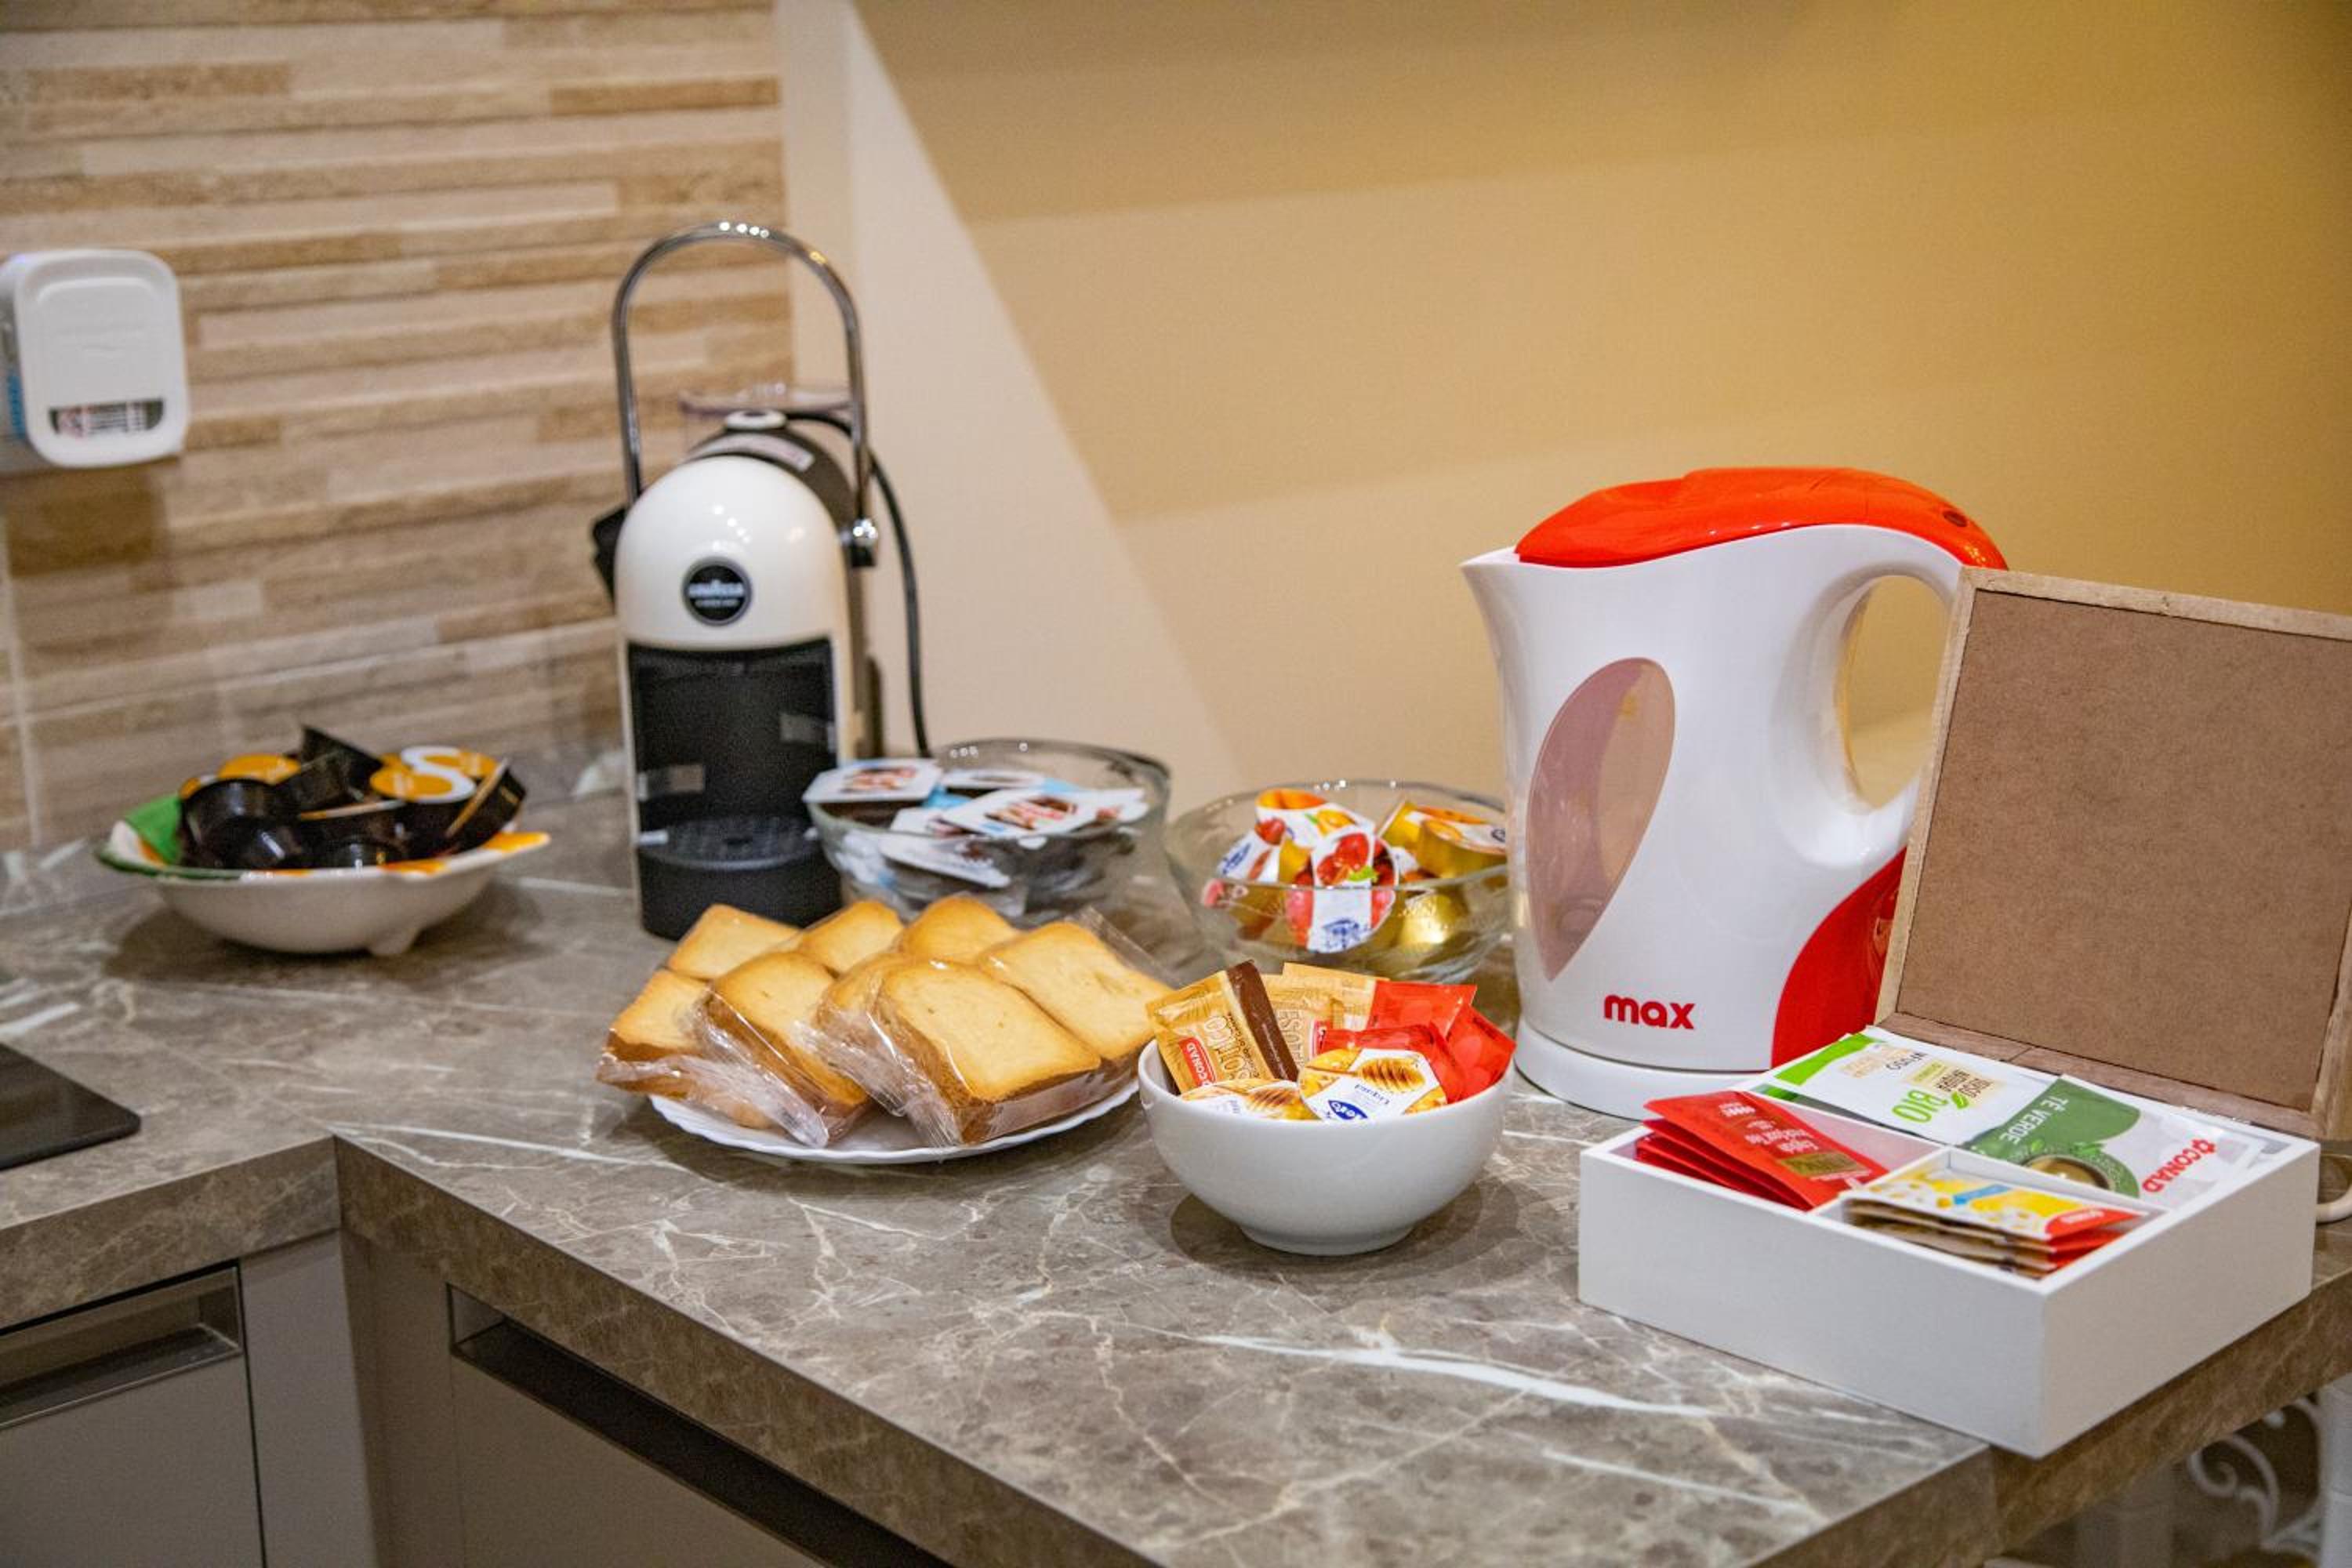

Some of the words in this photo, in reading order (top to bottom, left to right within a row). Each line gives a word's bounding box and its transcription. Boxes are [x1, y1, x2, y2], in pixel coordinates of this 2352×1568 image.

[1604, 994, 1695, 1030] max
[1892, 1091, 1949, 1123] BIO
[2142, 1148, 2201, 1192] CONAD
